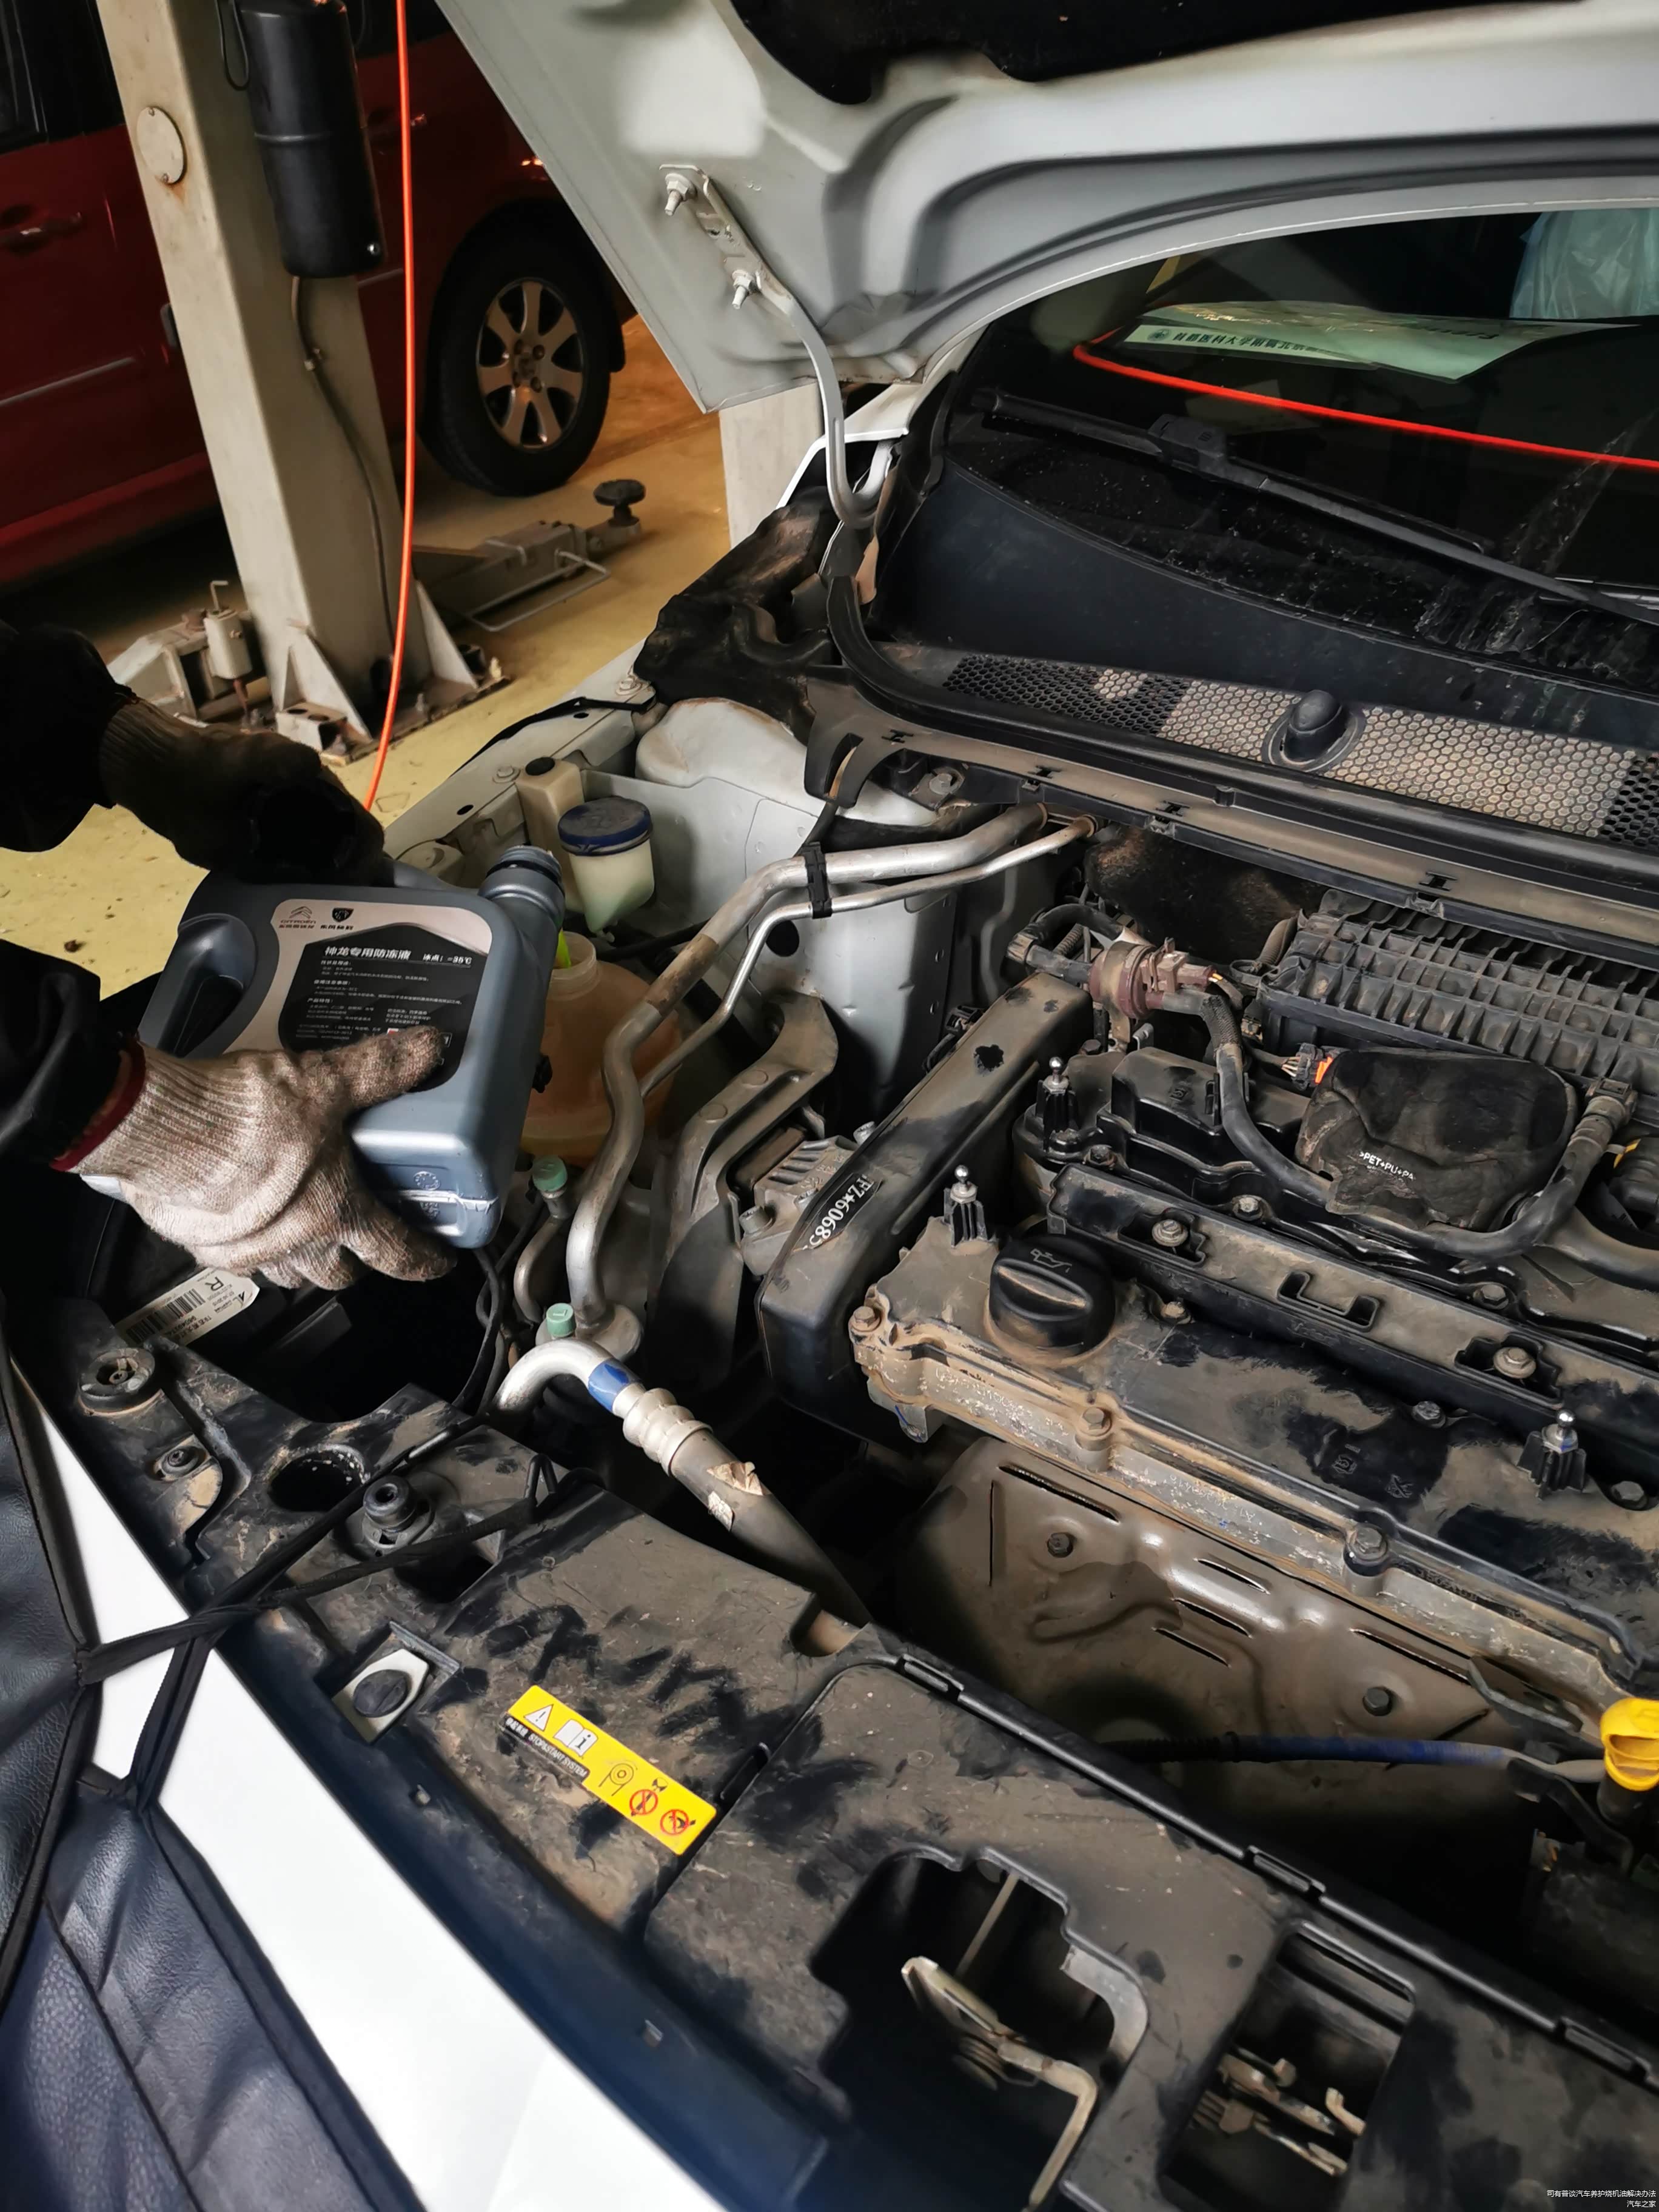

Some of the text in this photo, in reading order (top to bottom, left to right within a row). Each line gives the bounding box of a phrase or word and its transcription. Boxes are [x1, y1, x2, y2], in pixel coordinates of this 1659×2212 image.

[1173, 332, 1332, 353] 首都医科大学附属北京
[324, 946, 412, 961] 神龙专用防冻液
[205, 1276, 224, 1291] R
